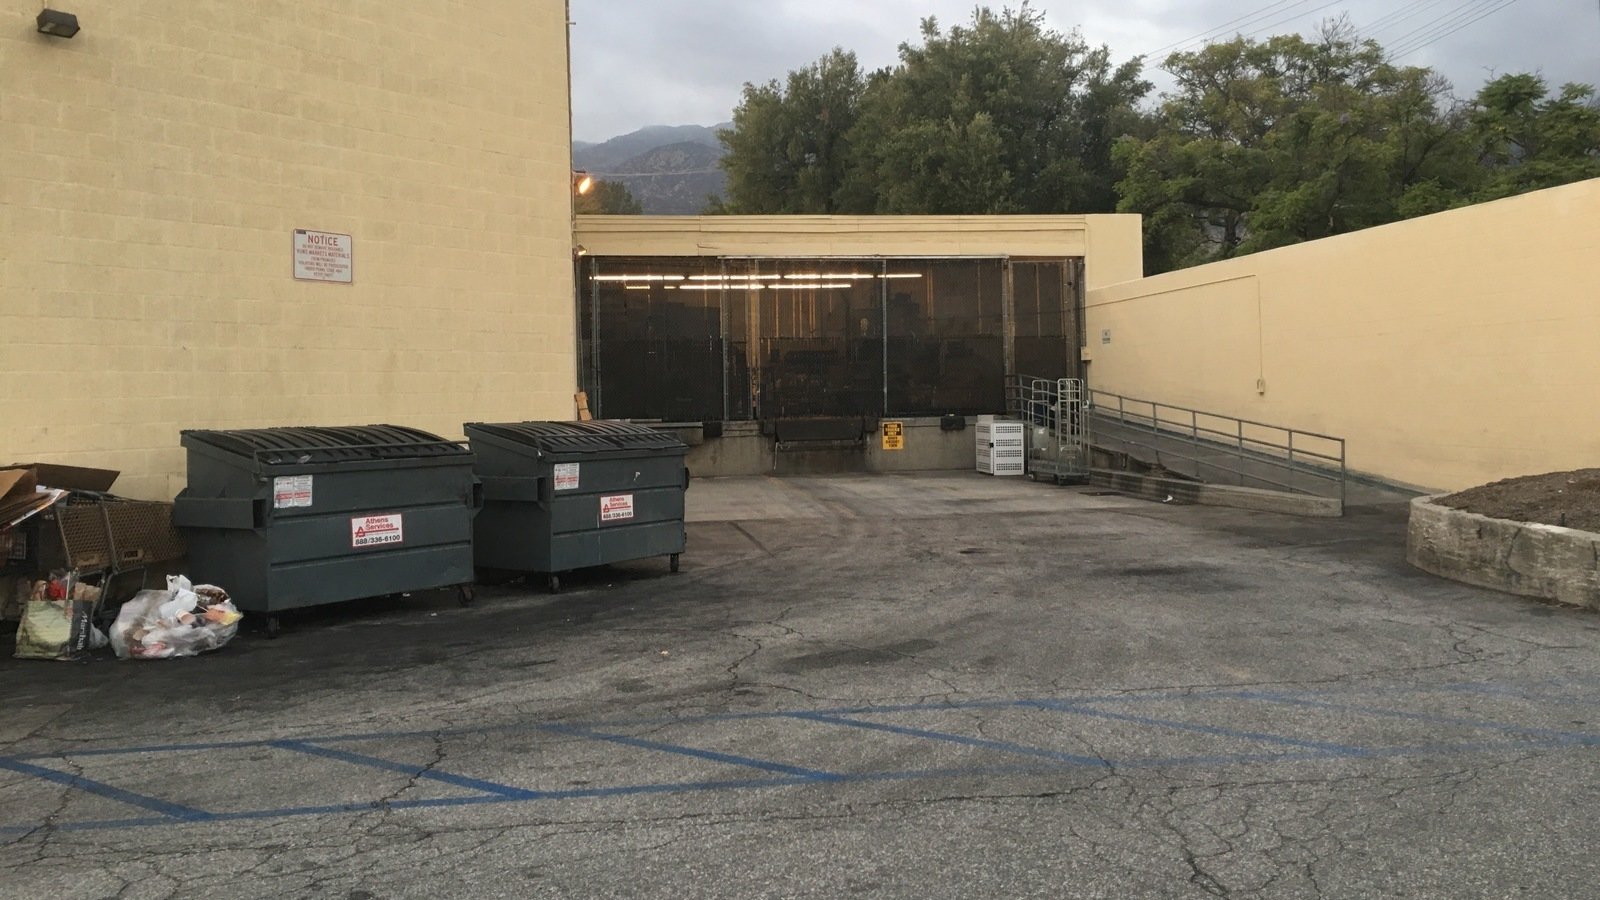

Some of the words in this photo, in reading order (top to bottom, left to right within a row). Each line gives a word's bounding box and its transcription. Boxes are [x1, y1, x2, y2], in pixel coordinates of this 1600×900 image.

[307, 234, 338, 246] NOTICE
[365, 522, 394, 530] Services
[355, 535, 400, 545] 888/336-6100
